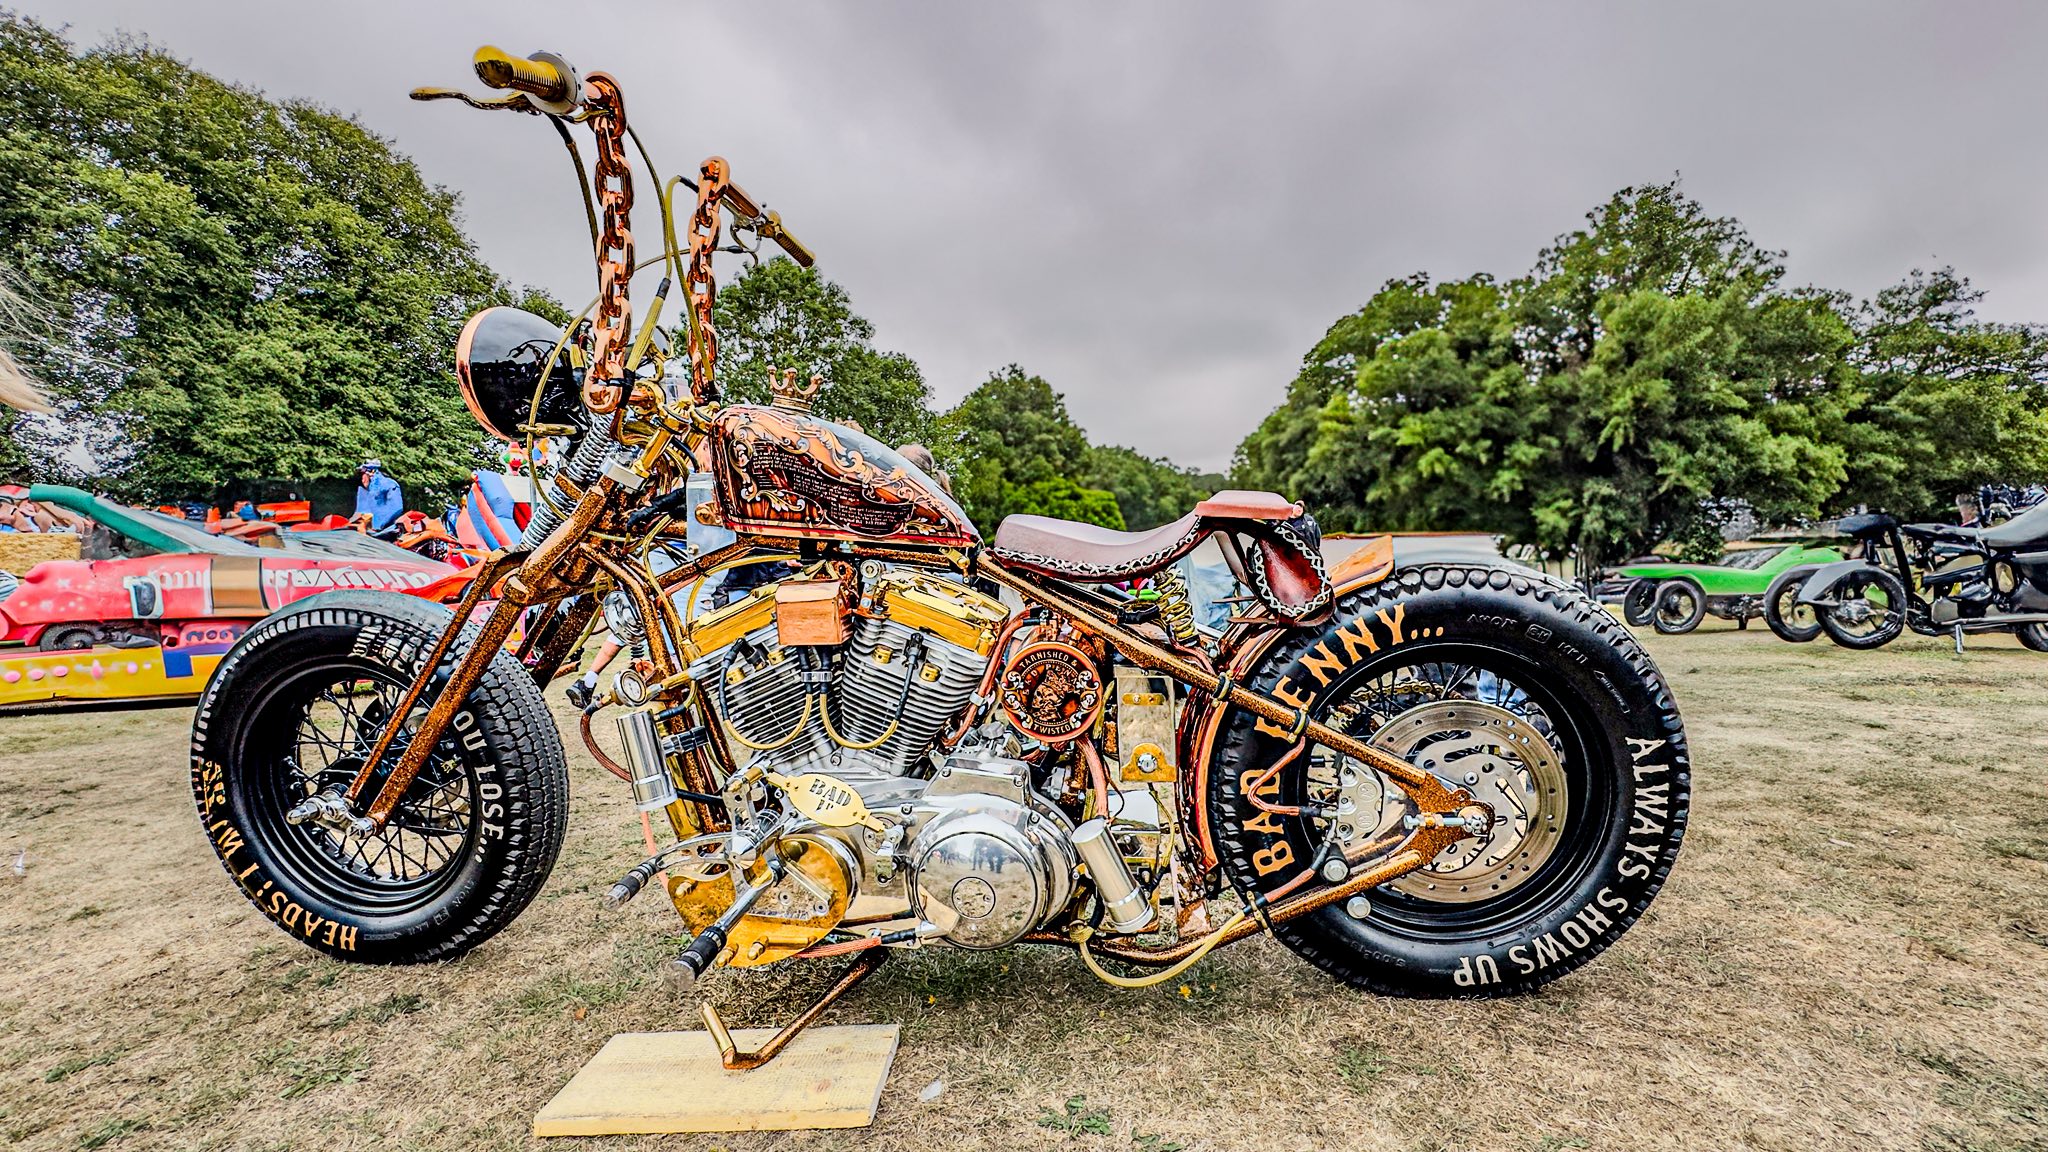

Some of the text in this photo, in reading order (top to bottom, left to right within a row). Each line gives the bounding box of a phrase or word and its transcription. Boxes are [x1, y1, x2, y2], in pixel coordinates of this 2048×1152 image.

[1033, 723, 1071, 735] TWISTED
[809, 778, 851, 806] BAD
[1240, 769, 1295, 876] BAD
[1453, 736, 1670, 987] ALWAYS SHOWS UP
